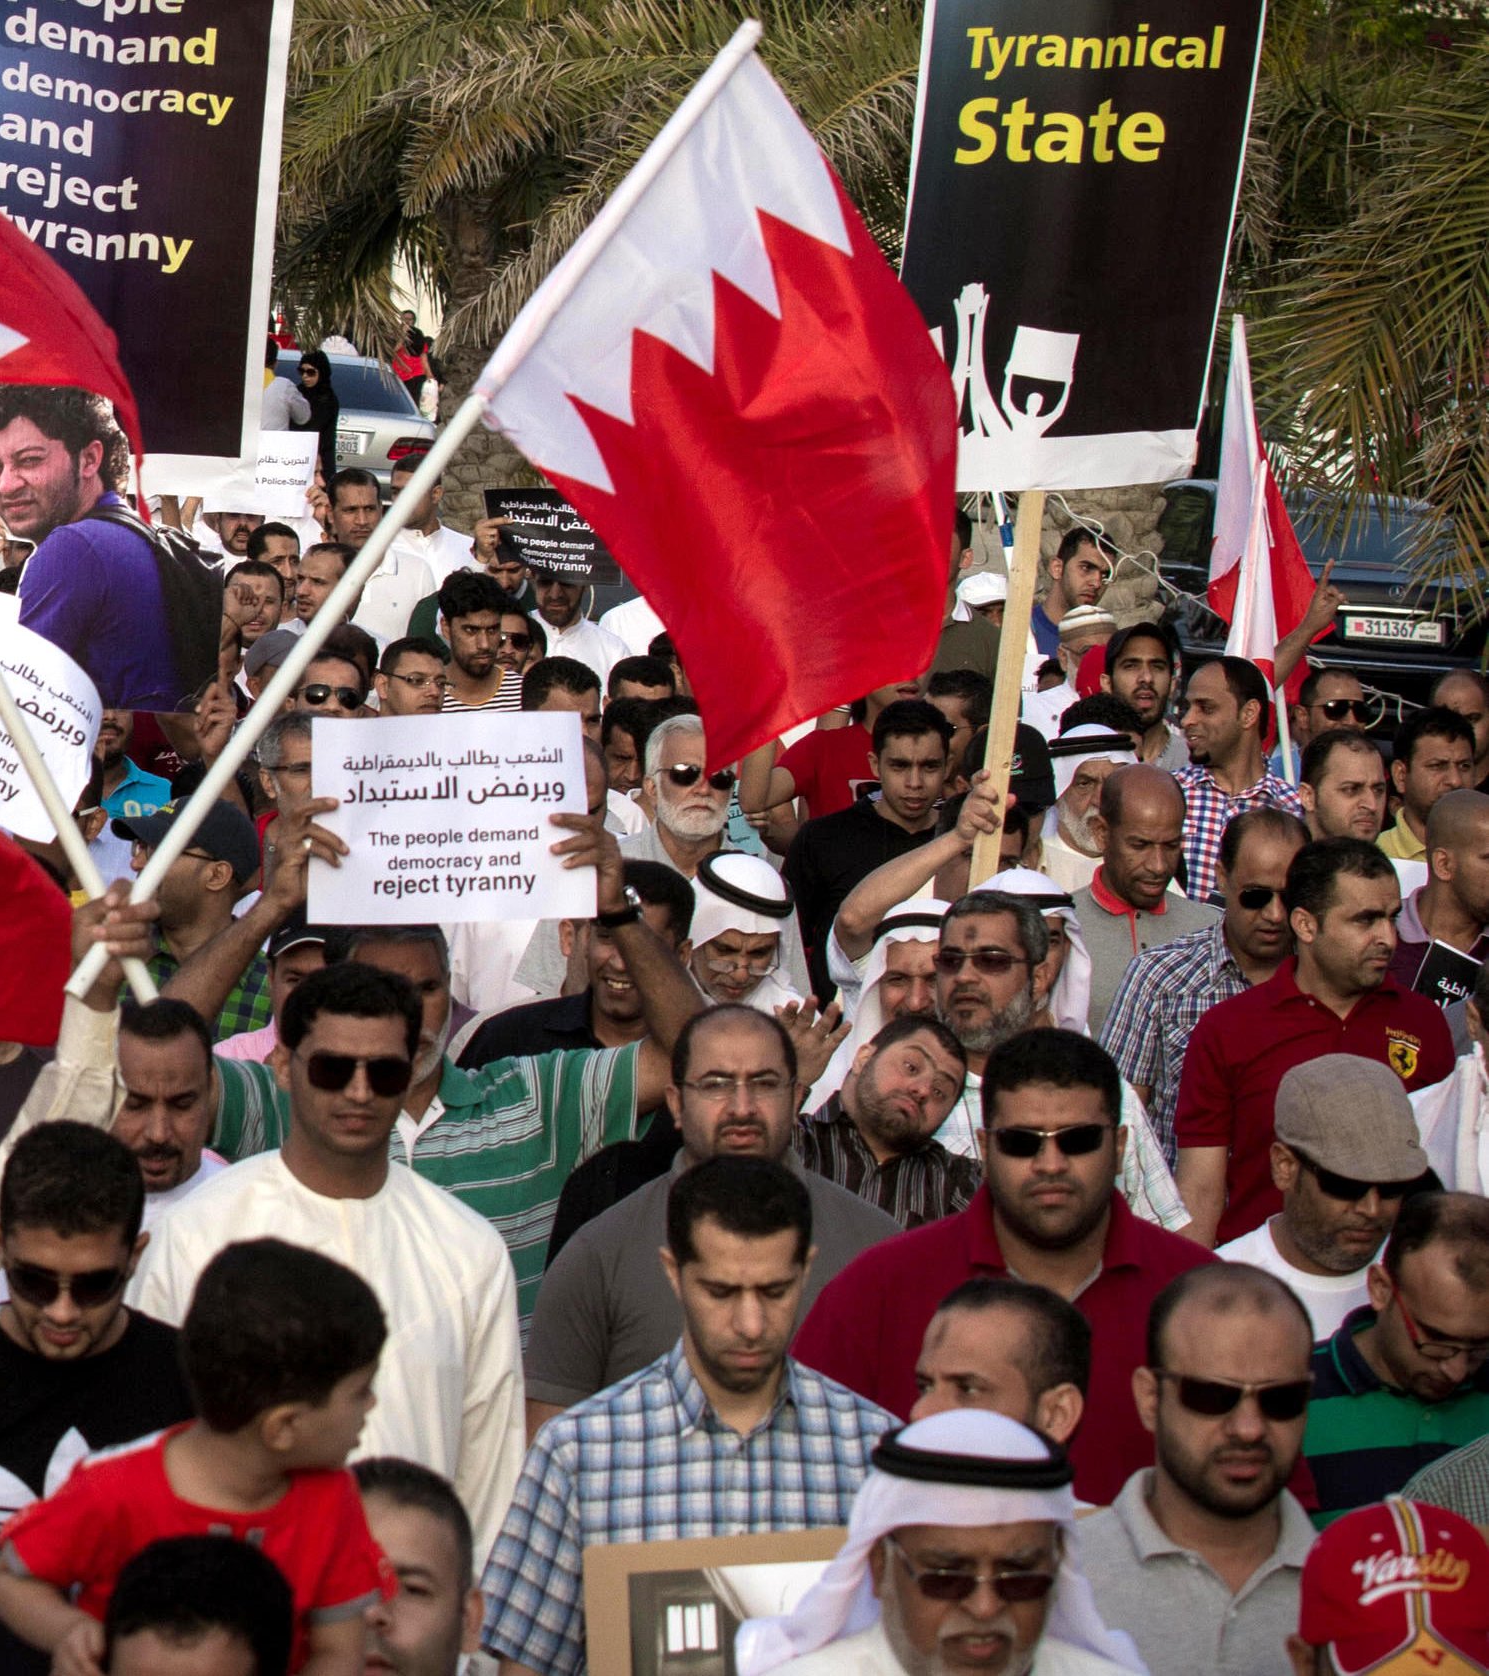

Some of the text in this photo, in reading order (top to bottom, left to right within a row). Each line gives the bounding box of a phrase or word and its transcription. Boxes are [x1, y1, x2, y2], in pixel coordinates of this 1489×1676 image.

[4, 7, 218, 66] demand
[966, 23, 1226, 80] Tyrannical
[2, 61, 234, 126] democracy
[954, 97, 1166, 164] State
[513, 534, 595, 550] The people demand
[569, 552, 586, 561] and
[548, 560, 592, 574] tyranny
[1366, 620, 1417, 638] 311367
[0, 660, 45, 692] يطالب
[48, 686, 94, 724] الشعب
[14, 695, 86, 746] ويرفض
[342, 746, 563, 774] الشعب يطالب بالديمقراطية
[343, 776, 565, 808] ويرفض الاستبداد
[368, 826, 540, 848] The people demand
[388, 852, 520, 871] democracy and
[373, 873, 536, 900] reject tyranny
